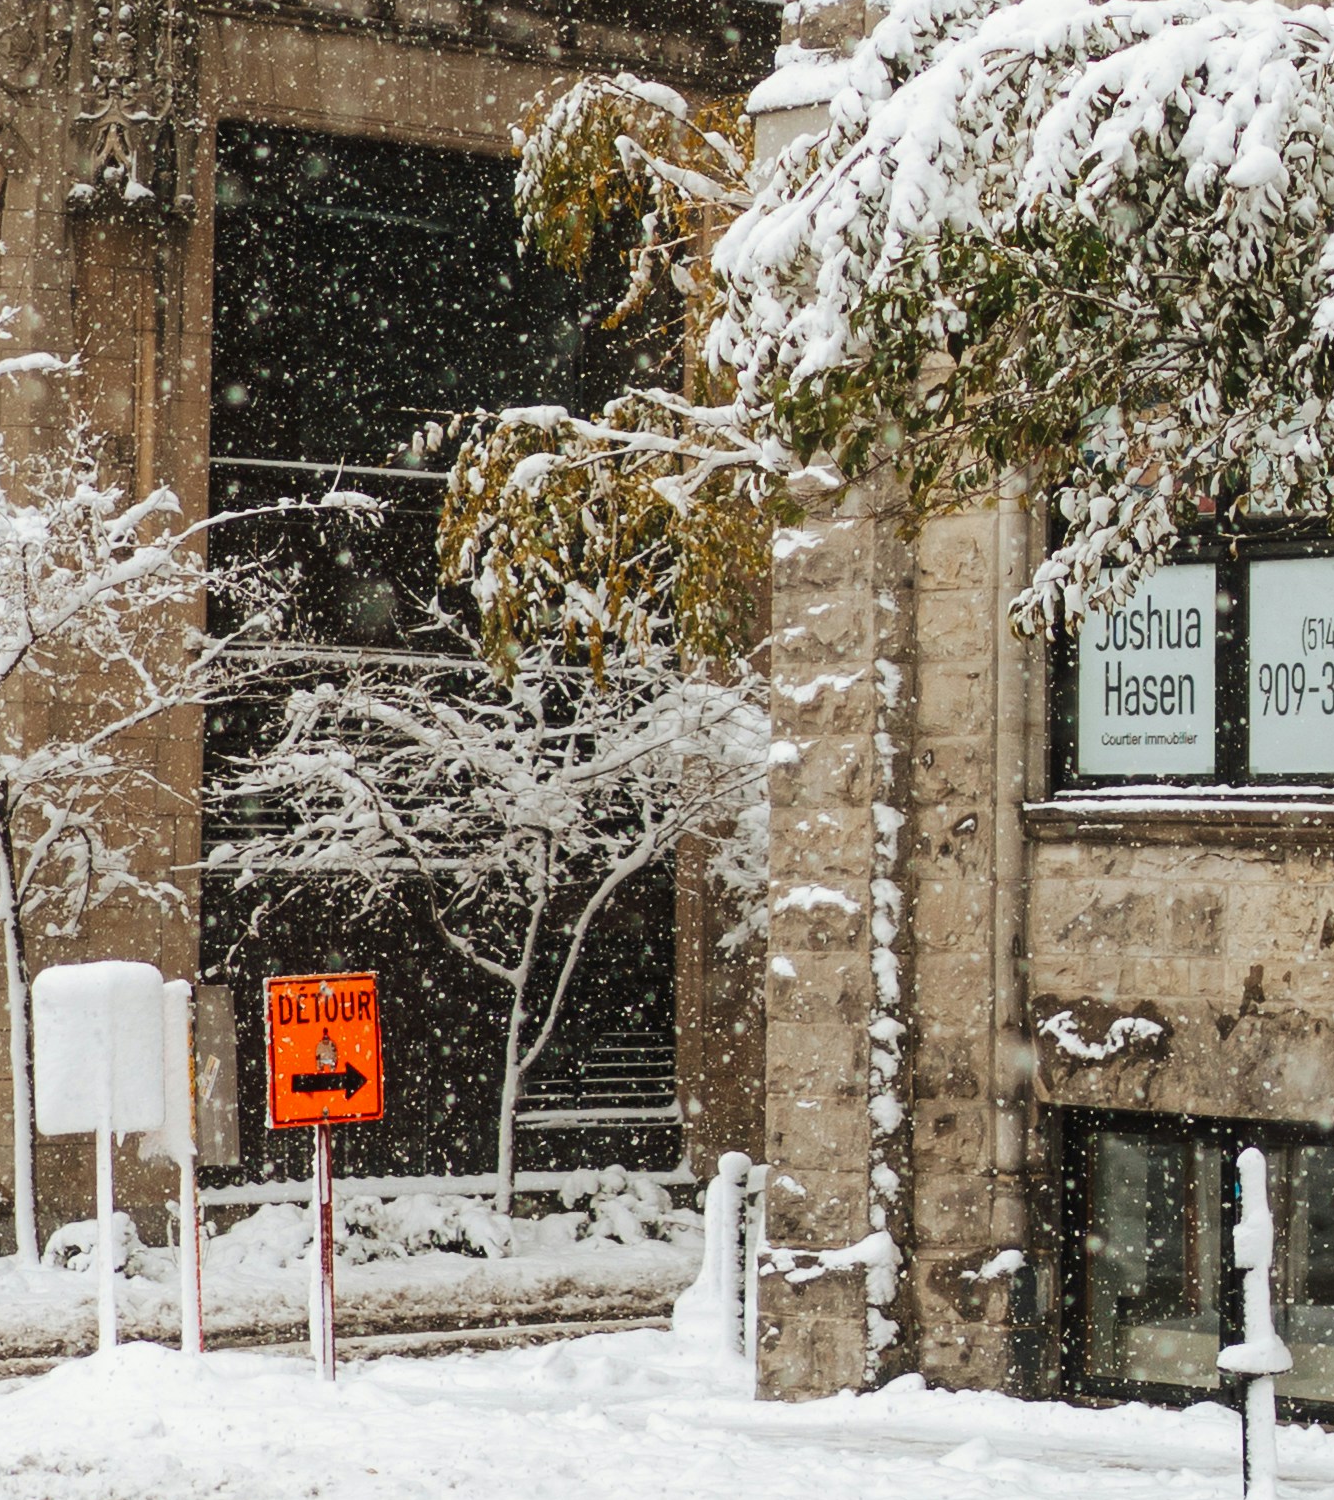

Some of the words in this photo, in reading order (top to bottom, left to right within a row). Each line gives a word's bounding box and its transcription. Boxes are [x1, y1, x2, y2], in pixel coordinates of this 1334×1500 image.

[1095, 595, 1201, 651] Joshua
[1104, 661, 1195, 717] Hasen
[1101, 732, 1142, 746] Courtier
[278, 986, 372, 1026] DÉTOUR
